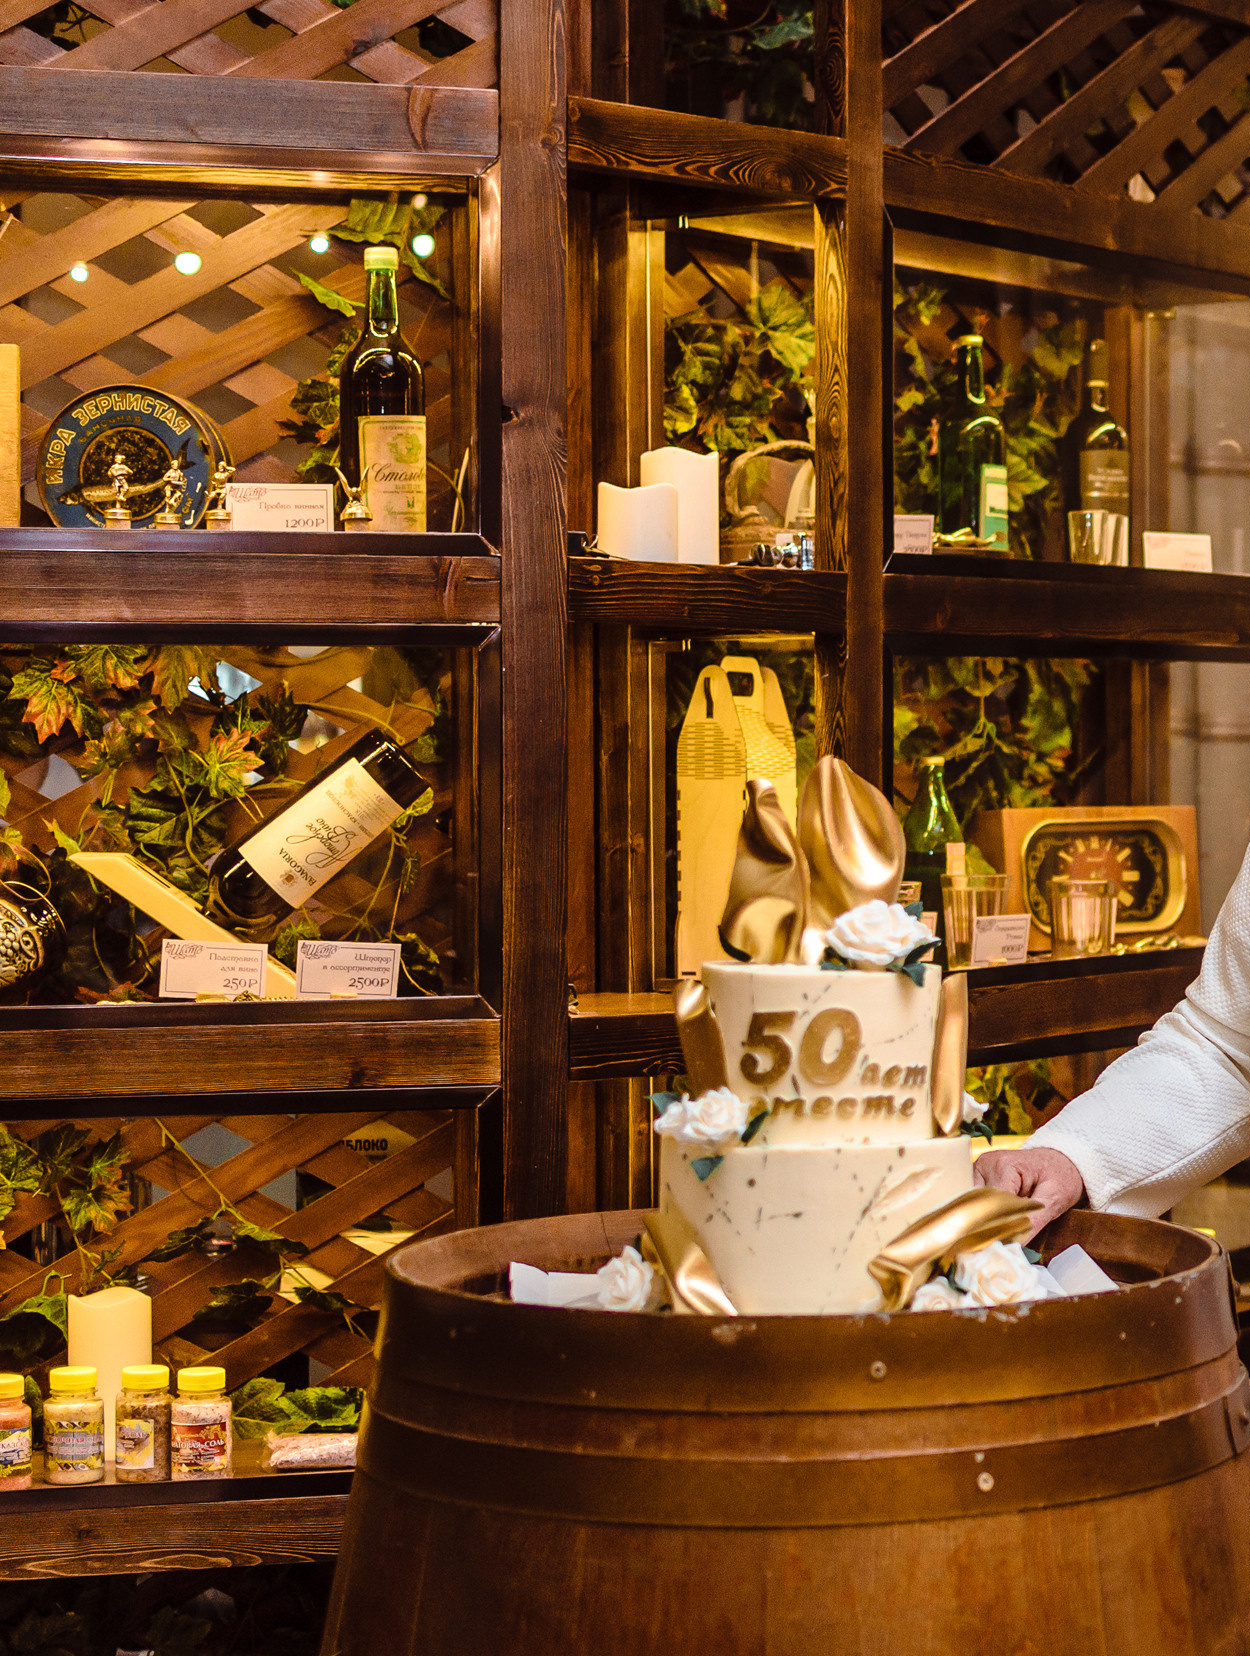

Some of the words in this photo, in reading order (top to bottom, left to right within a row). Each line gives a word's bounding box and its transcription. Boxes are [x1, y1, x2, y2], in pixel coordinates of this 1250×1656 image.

[46, 428, 76, 485] ИКРА
[71, 393, 192, 436] ЗЕРНИСТАЯ
[259, 501, 291, 511] Пробка
[316, 817, 358, 844] Вино
[278, 847, 317, 887] FANAGORIA
[209, 952, 259, 963] Подставка
[354, 953, 391, 964] Штопор
[329, 965, 390, 973] ассортименте
[740, 1007, 863, 1087] 50
[340, 1137, 389, 1151] БЛОКО
[204, 1438, 226, 1448] СОЛЬ
